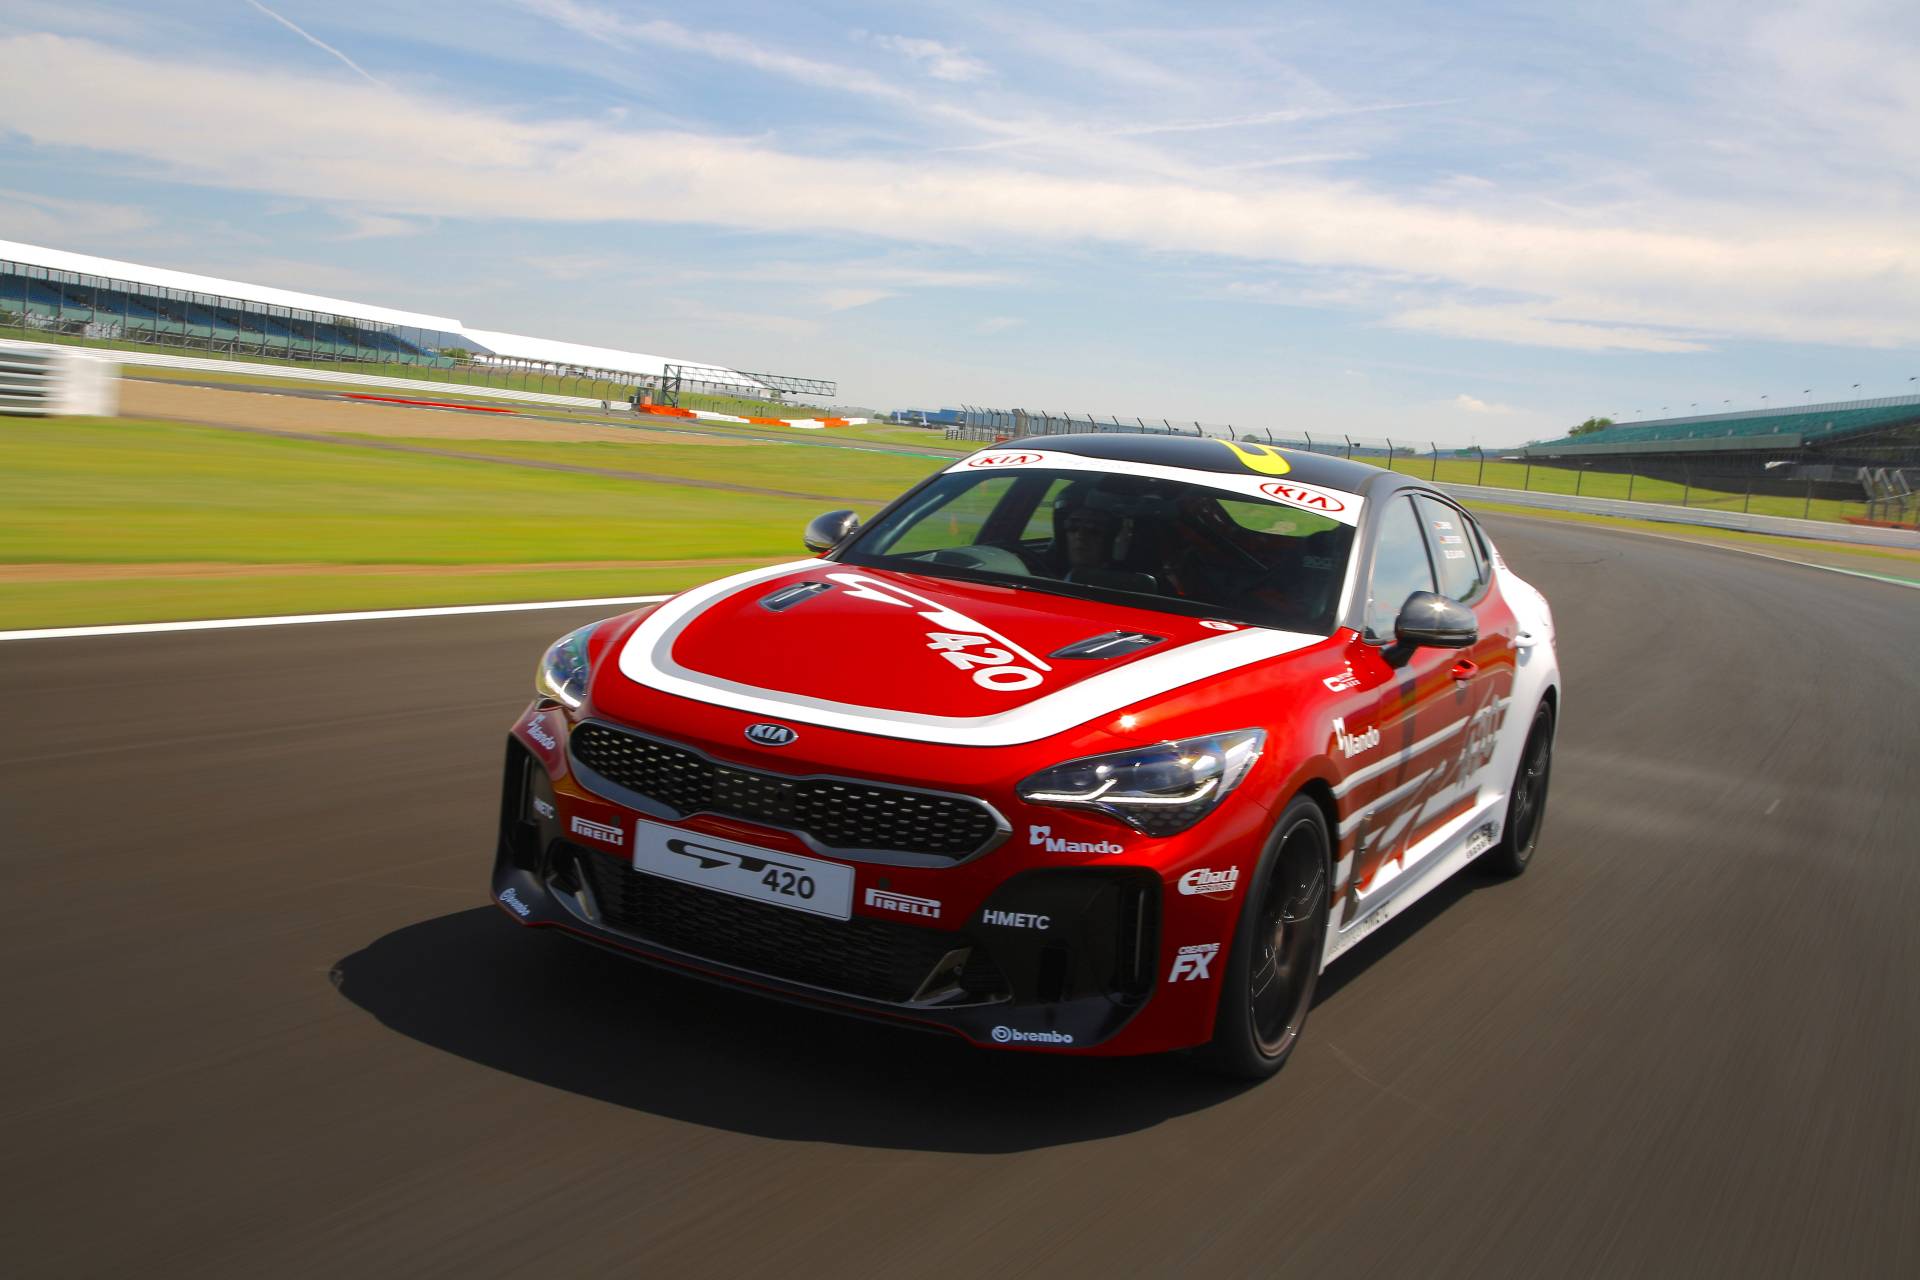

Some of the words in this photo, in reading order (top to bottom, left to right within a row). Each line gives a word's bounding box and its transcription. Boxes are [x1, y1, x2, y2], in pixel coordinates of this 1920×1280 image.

[979, 456, 1027, 465] KIA
[1273, 485, 1328, 509] KIA
[925, 632, 1044, 691] 420
[750, 724, 788, 742] KIA
[571, 816, 624, 846] PIRELLI
[1045, 837, 1124, 854] Mando
[761, 869, 816, 900] 420
[865, 888, 942, 919] PIRELLI
[983, 909, 1050, 930] HMETC
[1168, 951, 1218, 983] FX
[1012, 1028, 1073, 1044] brembo
